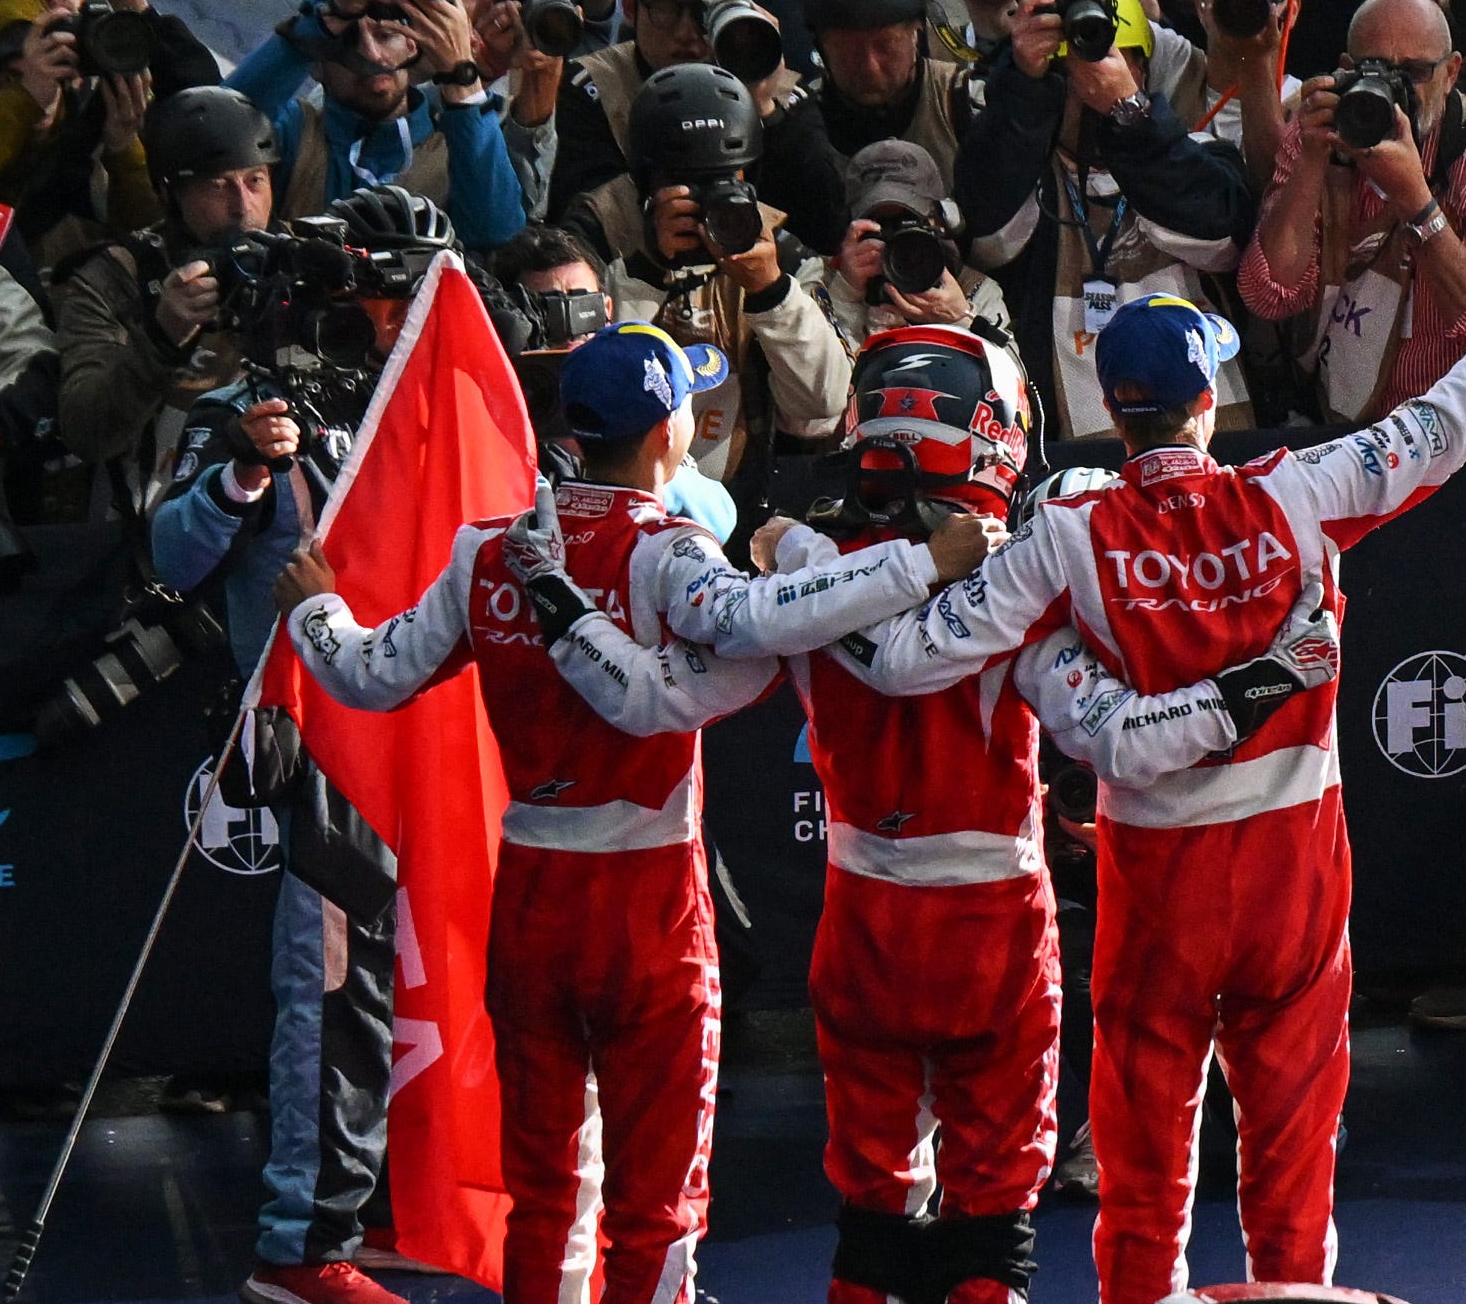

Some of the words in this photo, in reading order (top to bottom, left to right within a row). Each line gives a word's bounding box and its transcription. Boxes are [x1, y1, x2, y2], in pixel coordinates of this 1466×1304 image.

[681, 118, 725, 131] DPPI
[969, 401, 1015, 447] Red
[1157, 492, 1207, 515] DENSO
[1104, 530, 1293, 594] TOYOTA
[1110, 570, 1291, 613] RACING
[1121, 703, 1193, 731] RICHARD
[794, 790, 826, 814] FI
